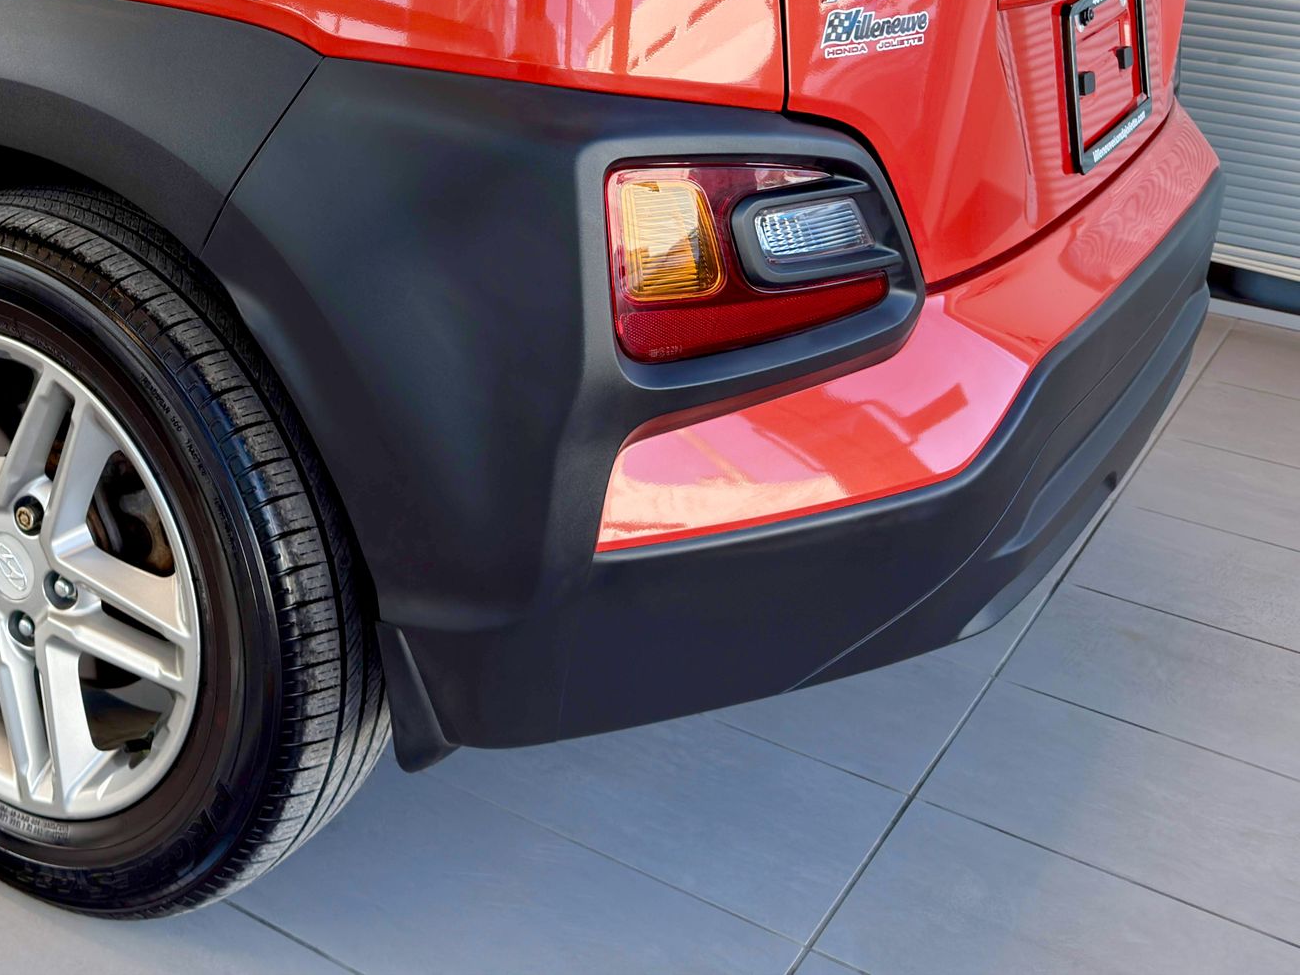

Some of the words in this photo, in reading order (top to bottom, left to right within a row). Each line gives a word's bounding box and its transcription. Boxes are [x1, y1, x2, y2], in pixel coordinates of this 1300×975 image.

[824, 8, 928, 43] Villeneuve
[826, 45, 867, 57] HONDA
[877, 36, 923, 49] JOLIETTE
